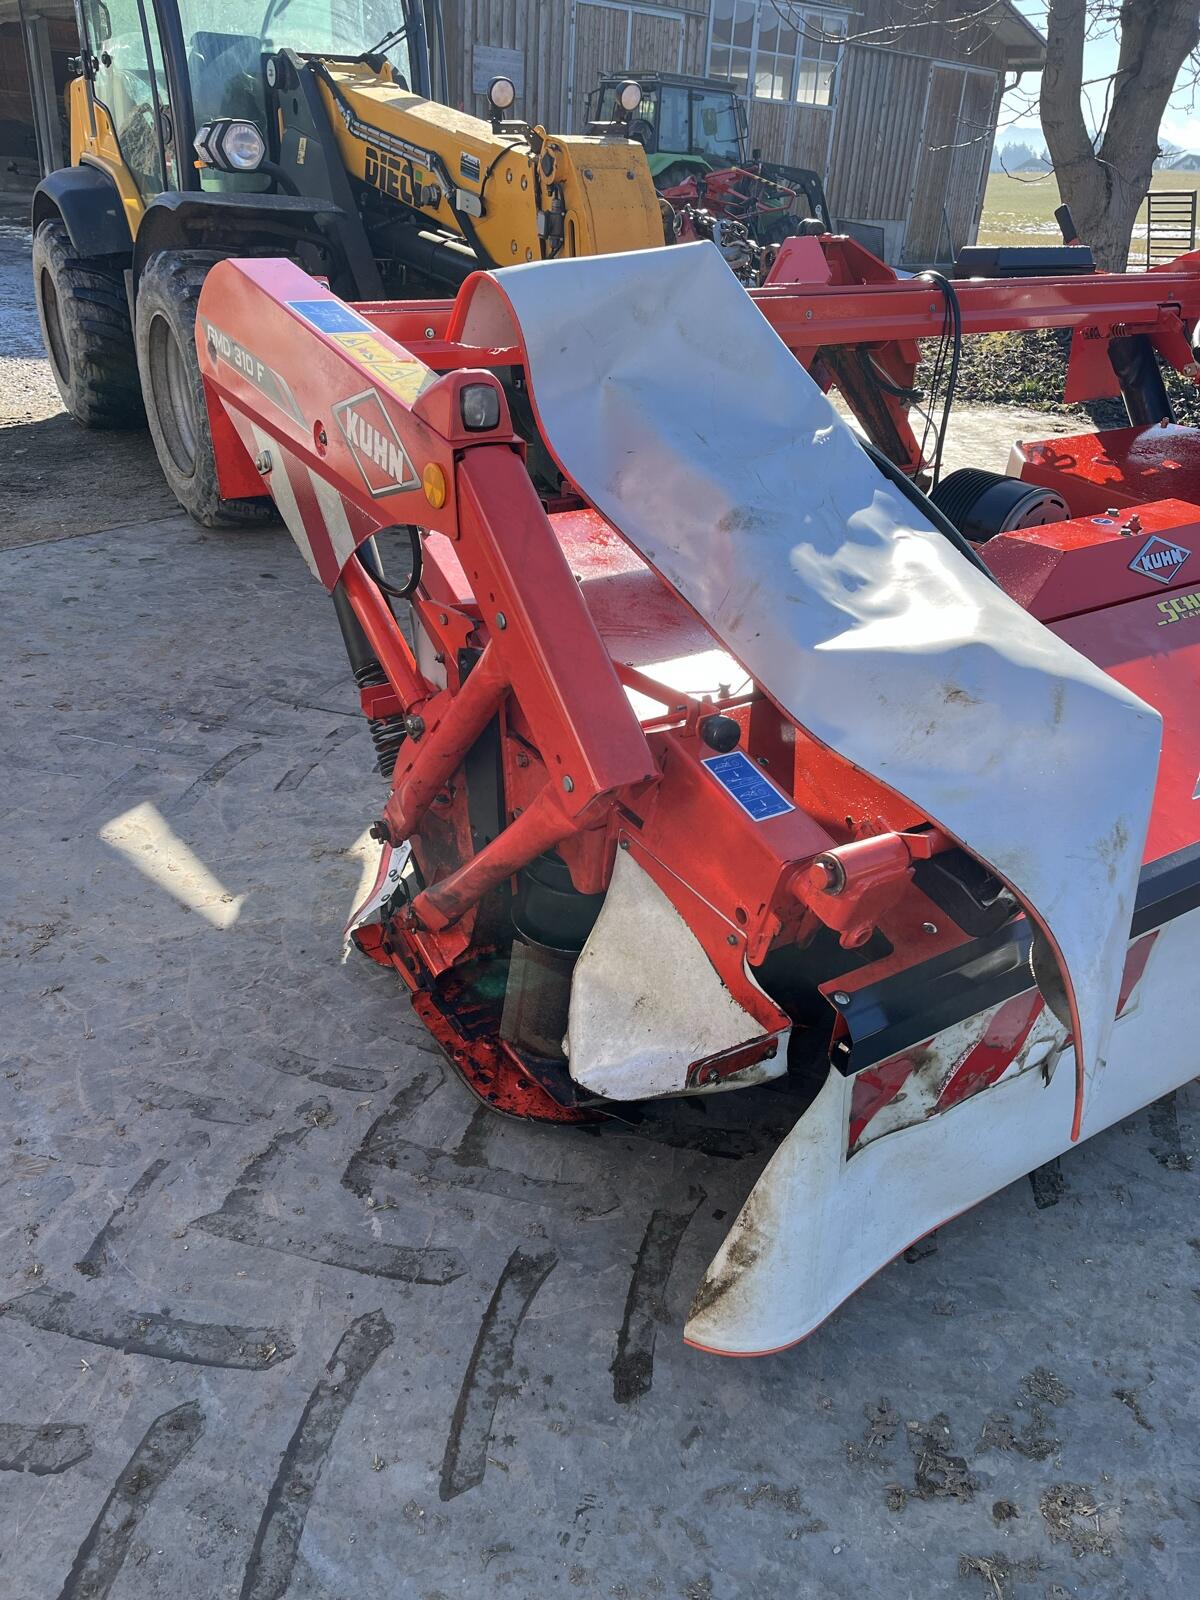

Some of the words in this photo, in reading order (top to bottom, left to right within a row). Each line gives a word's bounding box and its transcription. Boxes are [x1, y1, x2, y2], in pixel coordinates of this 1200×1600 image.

[234, 345, 254, 376] 310
[256, 362, 265, 382] F
[346, 407, 405, 485] KUHN
[1140, 548, 1183, 572] KUHN
